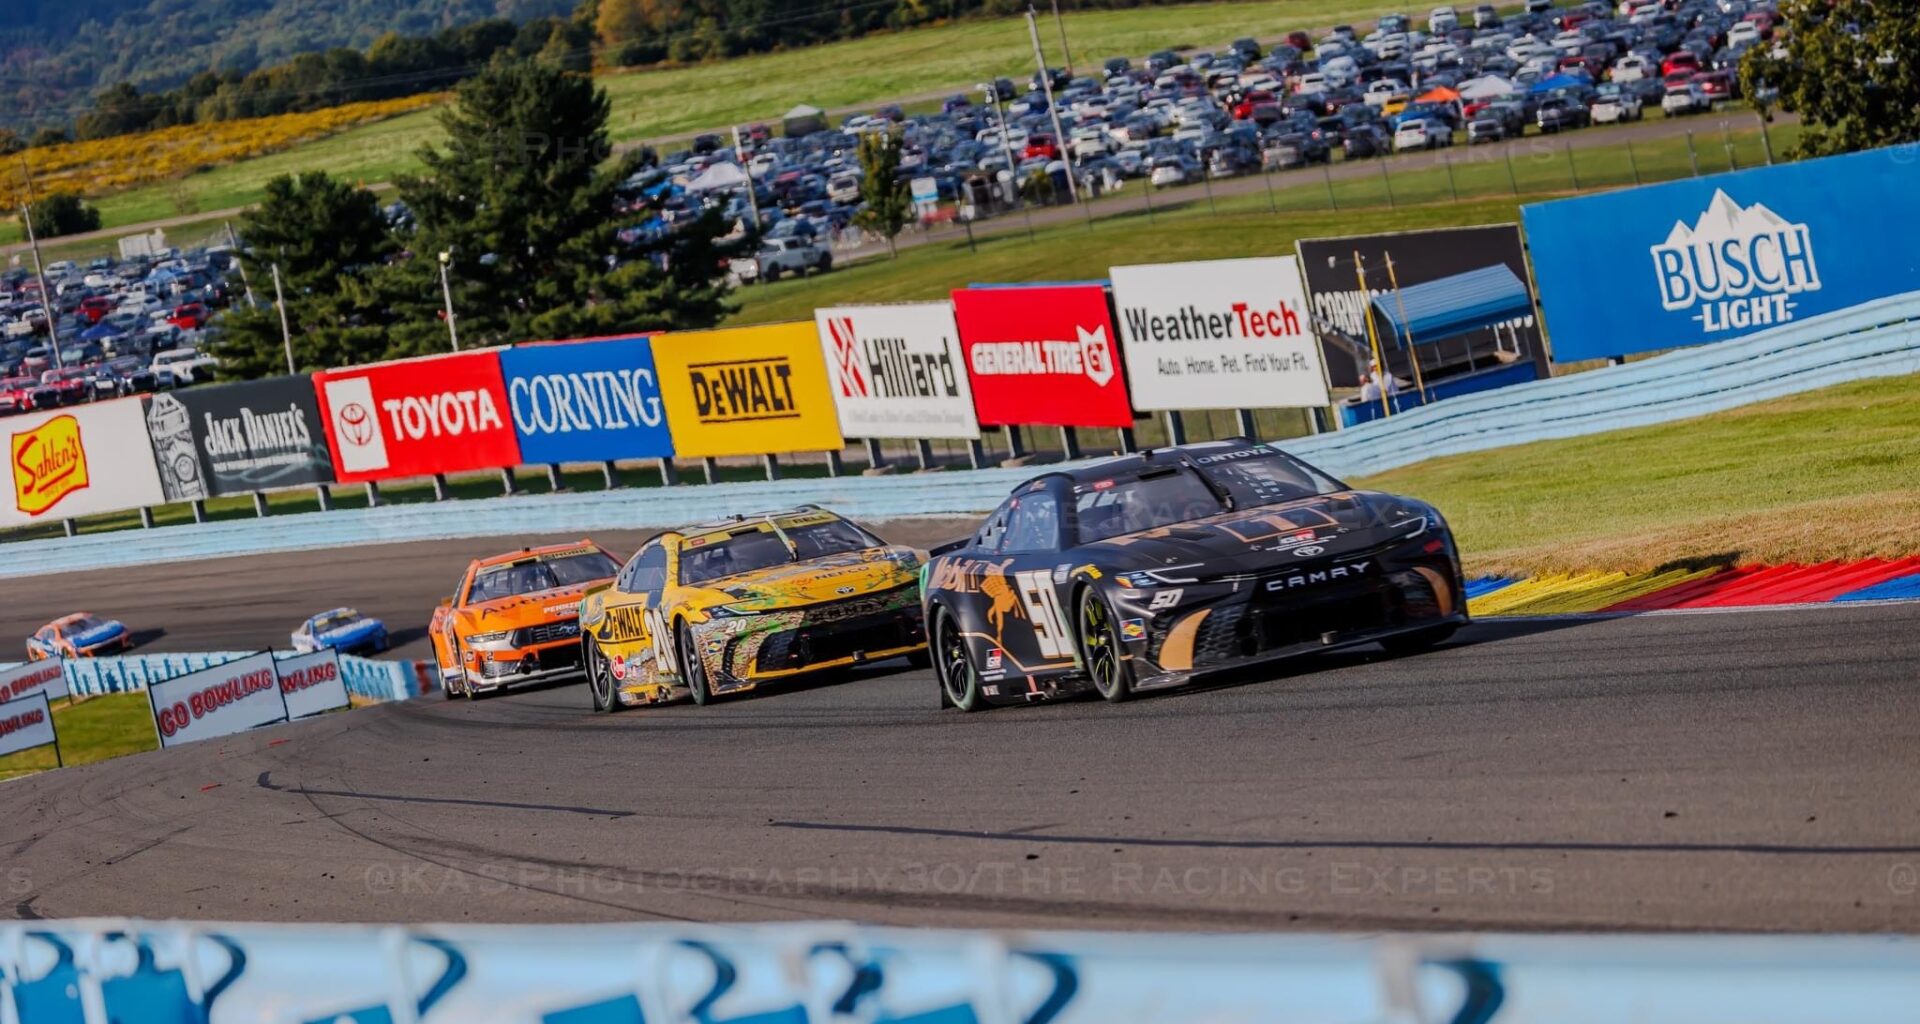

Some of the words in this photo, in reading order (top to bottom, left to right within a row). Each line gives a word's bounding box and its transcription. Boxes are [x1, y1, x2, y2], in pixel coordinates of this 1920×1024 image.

[1654, 225, 1817, 308] BUSCH
[1125, 300, 1302, 342] WeatherTech
[1314, 287, 1379, 335] CORNI
[1701, 294, 1790, 332] LIGHT
[864, 336, 960, 398] Hilliard
[971, 341, 1047, 375] GENERAL
[1042, 340, 1084, 375] TIRE
[1186, 356, 1216, 374] Home.
[1221, 354, 1241, 373] Pet.
[1245, 353, 1267, 372] Find
[1269, 352, 1290, 371] Your
[382, 388, 503, 442] TOYOTA
[509, 367, 661, 436] CORNING
[16, 435, 78, 495] Sahlen's
[1266, 561, 1370, 591] CAMRY
[1015, 568, 1077, 659] 50
[1148, 588, 1184, 610] 50
[727, 619, 747, 634] 20
[280, 662, 337, 695] WLING
[0, 708, 44, 738] WLING
[159, 701, 190, 737] GO
[188, 668, 274, 718] BOWLING
